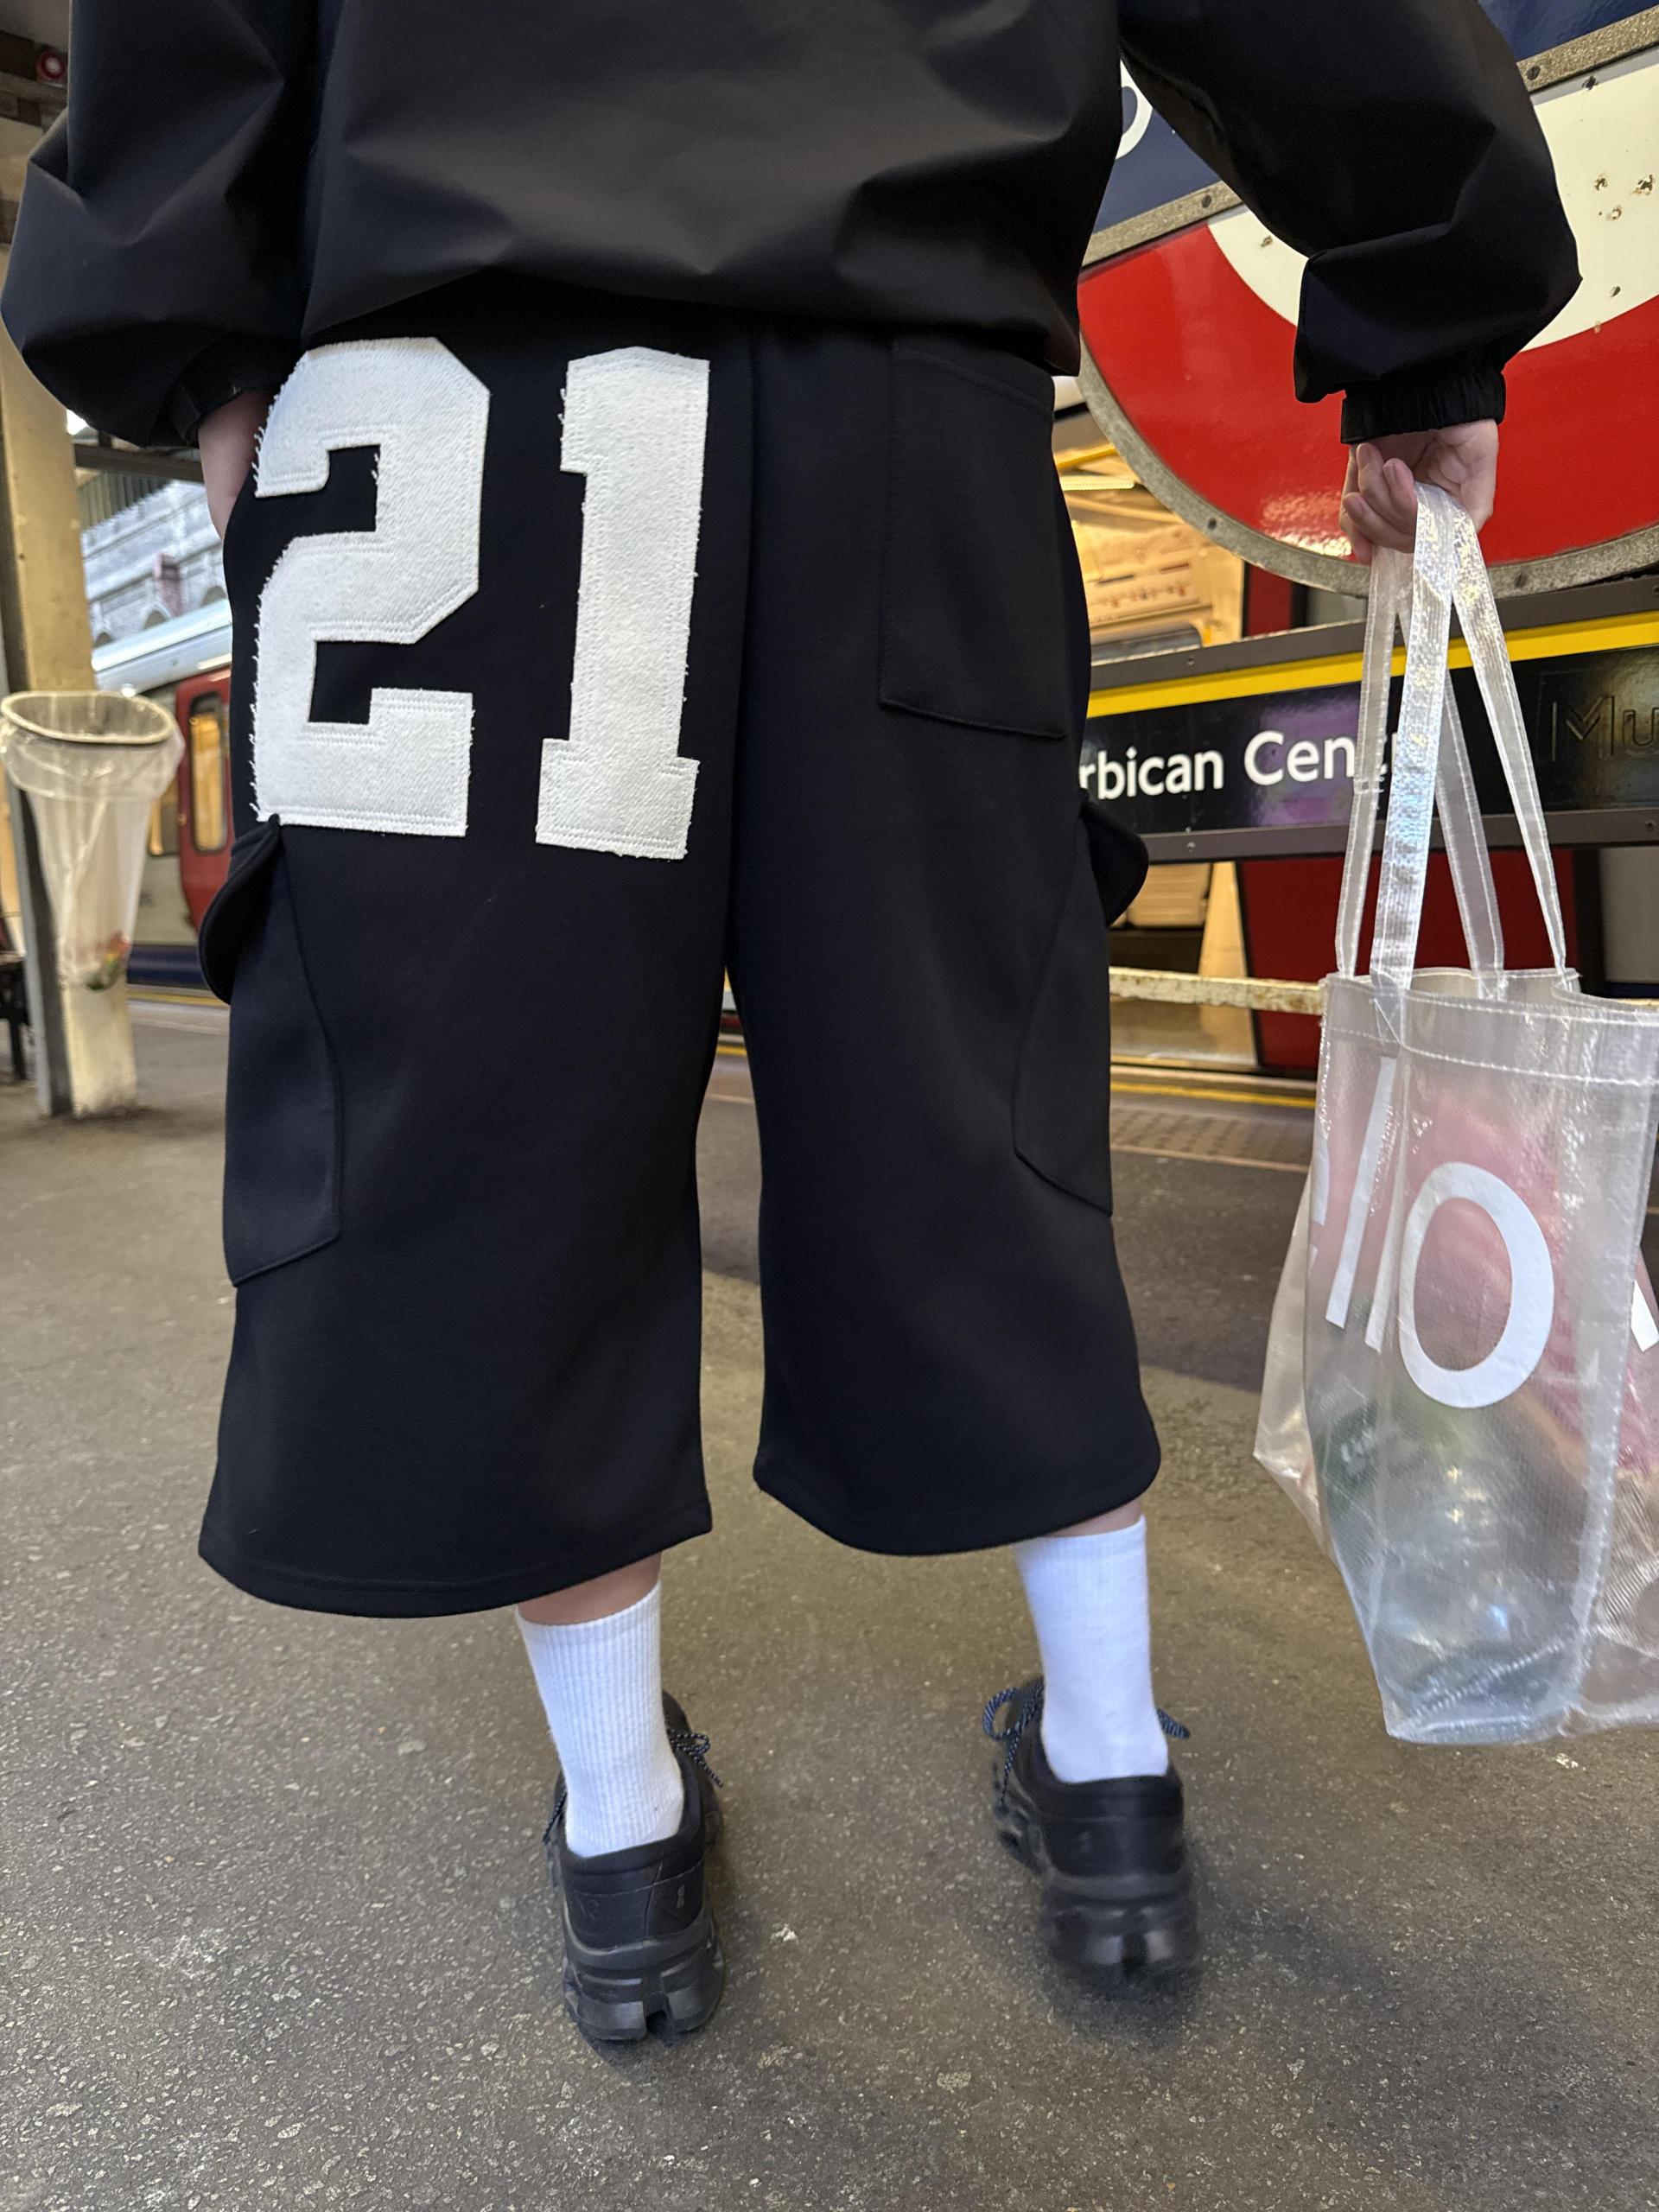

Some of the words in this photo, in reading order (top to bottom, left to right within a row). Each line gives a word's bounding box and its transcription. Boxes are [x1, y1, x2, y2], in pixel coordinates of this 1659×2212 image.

[251, 336, 710, 861] 21
[1078, 746, 1224, 800] rbican
[1243, 730, 1398, 786] Cen
